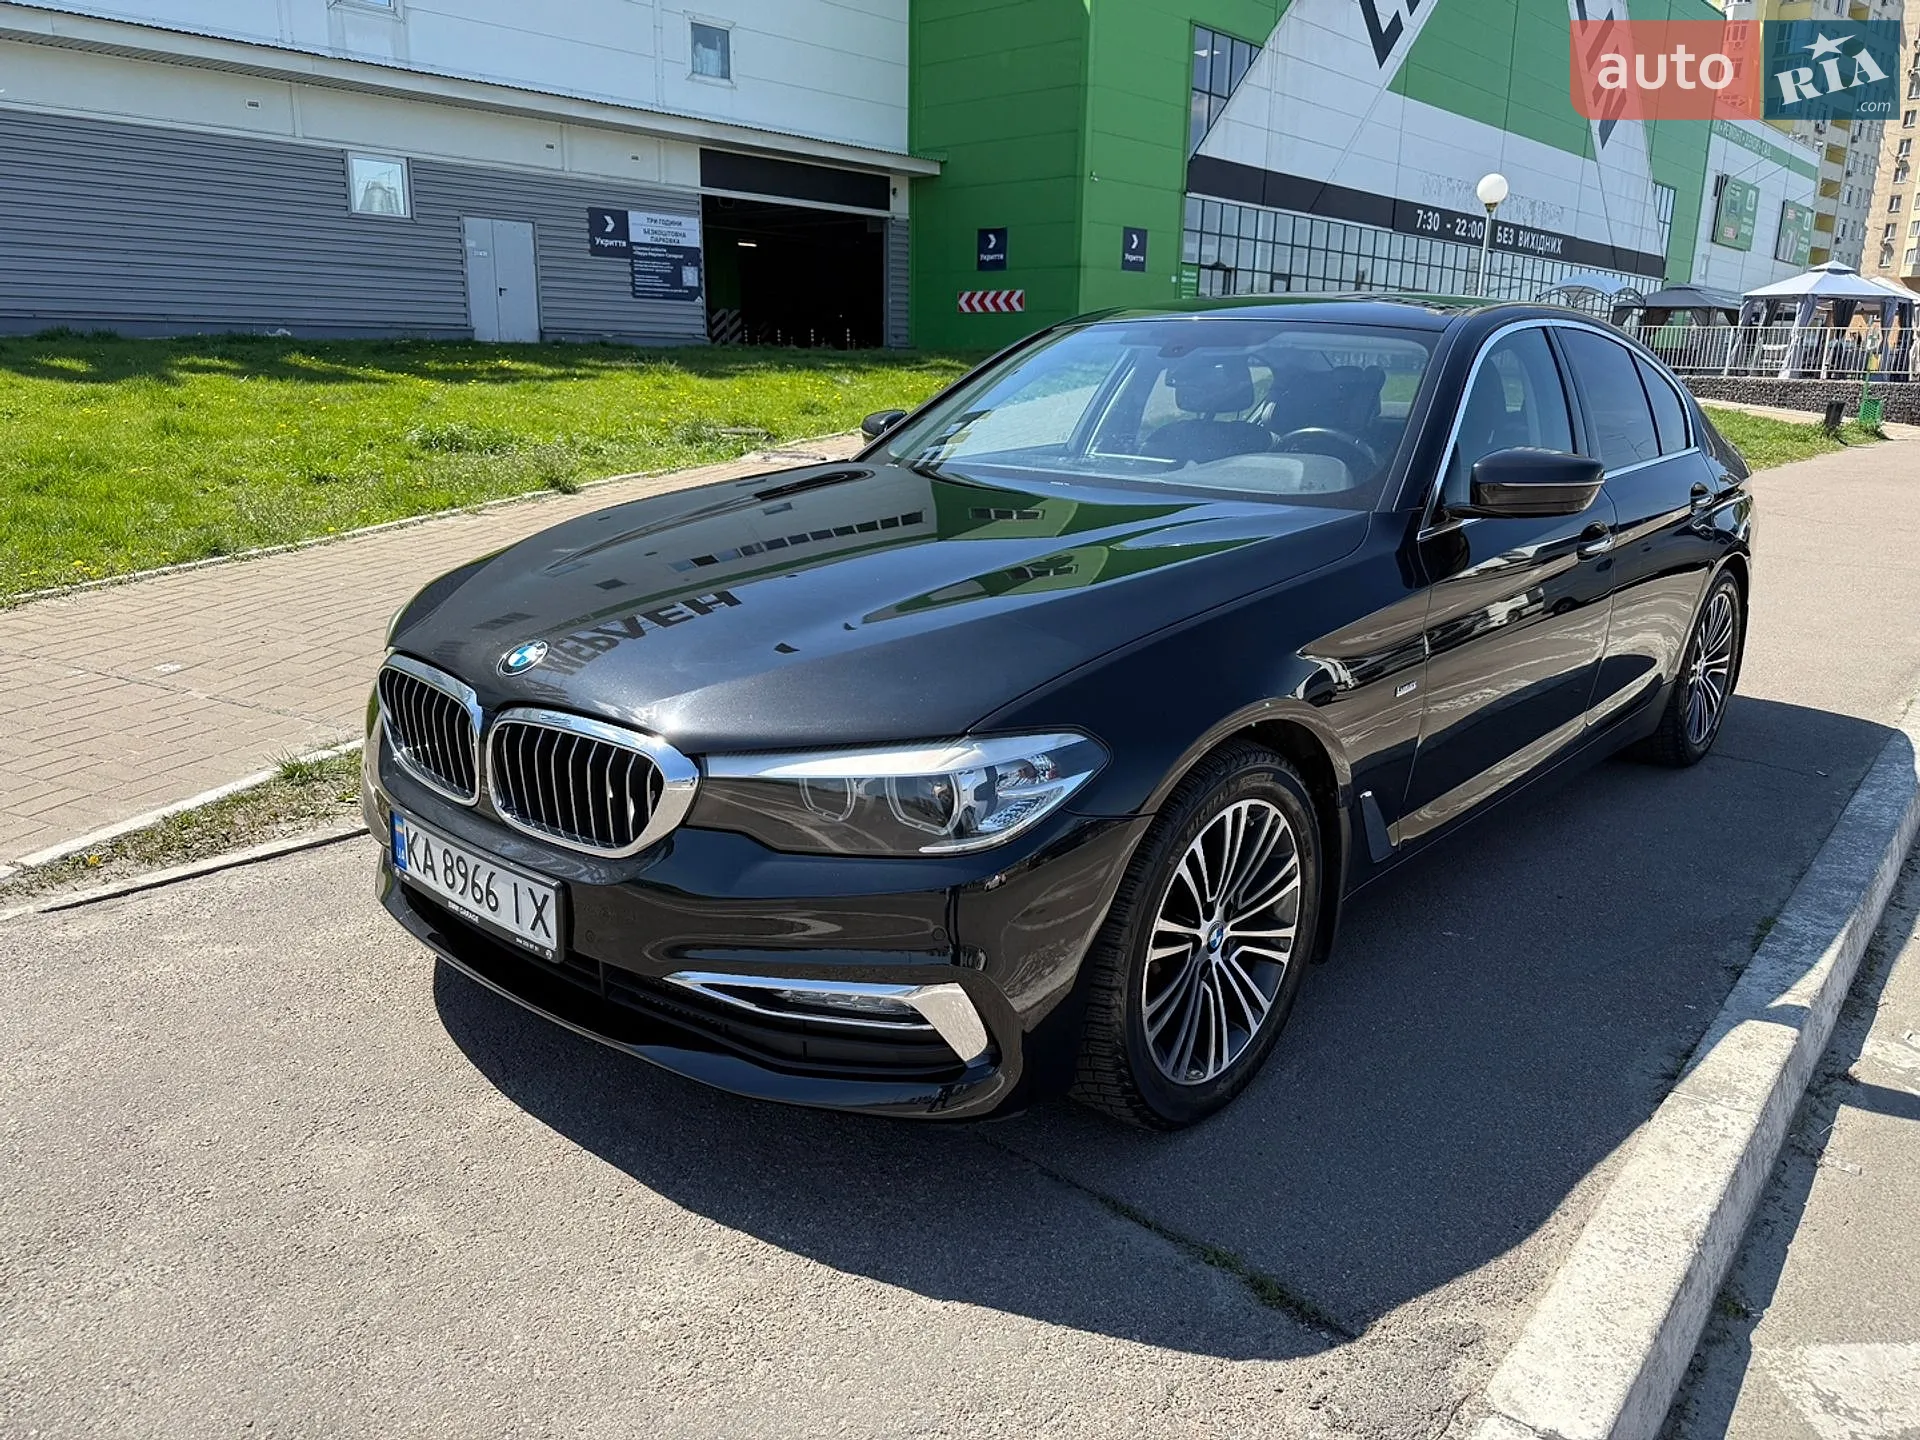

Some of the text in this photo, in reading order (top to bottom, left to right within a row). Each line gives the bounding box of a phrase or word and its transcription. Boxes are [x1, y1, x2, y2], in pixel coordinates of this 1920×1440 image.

[1415, 209, 1440, 232] 7:30
[1455, 218, 1483, 240] 22:00
[1496, 226, 1514, 246] БЕЗ
[1518, 230, 1563, 255] ВИХІДНИХ
[594, 237, 627, 248] Укриття
[979, 253, 1004, 263] Укриття
[1124, 253, 1144, 263] Укриття
[397, 845, 406, 860] UA
[405, 826, 551, 939] KA 8966 IX
